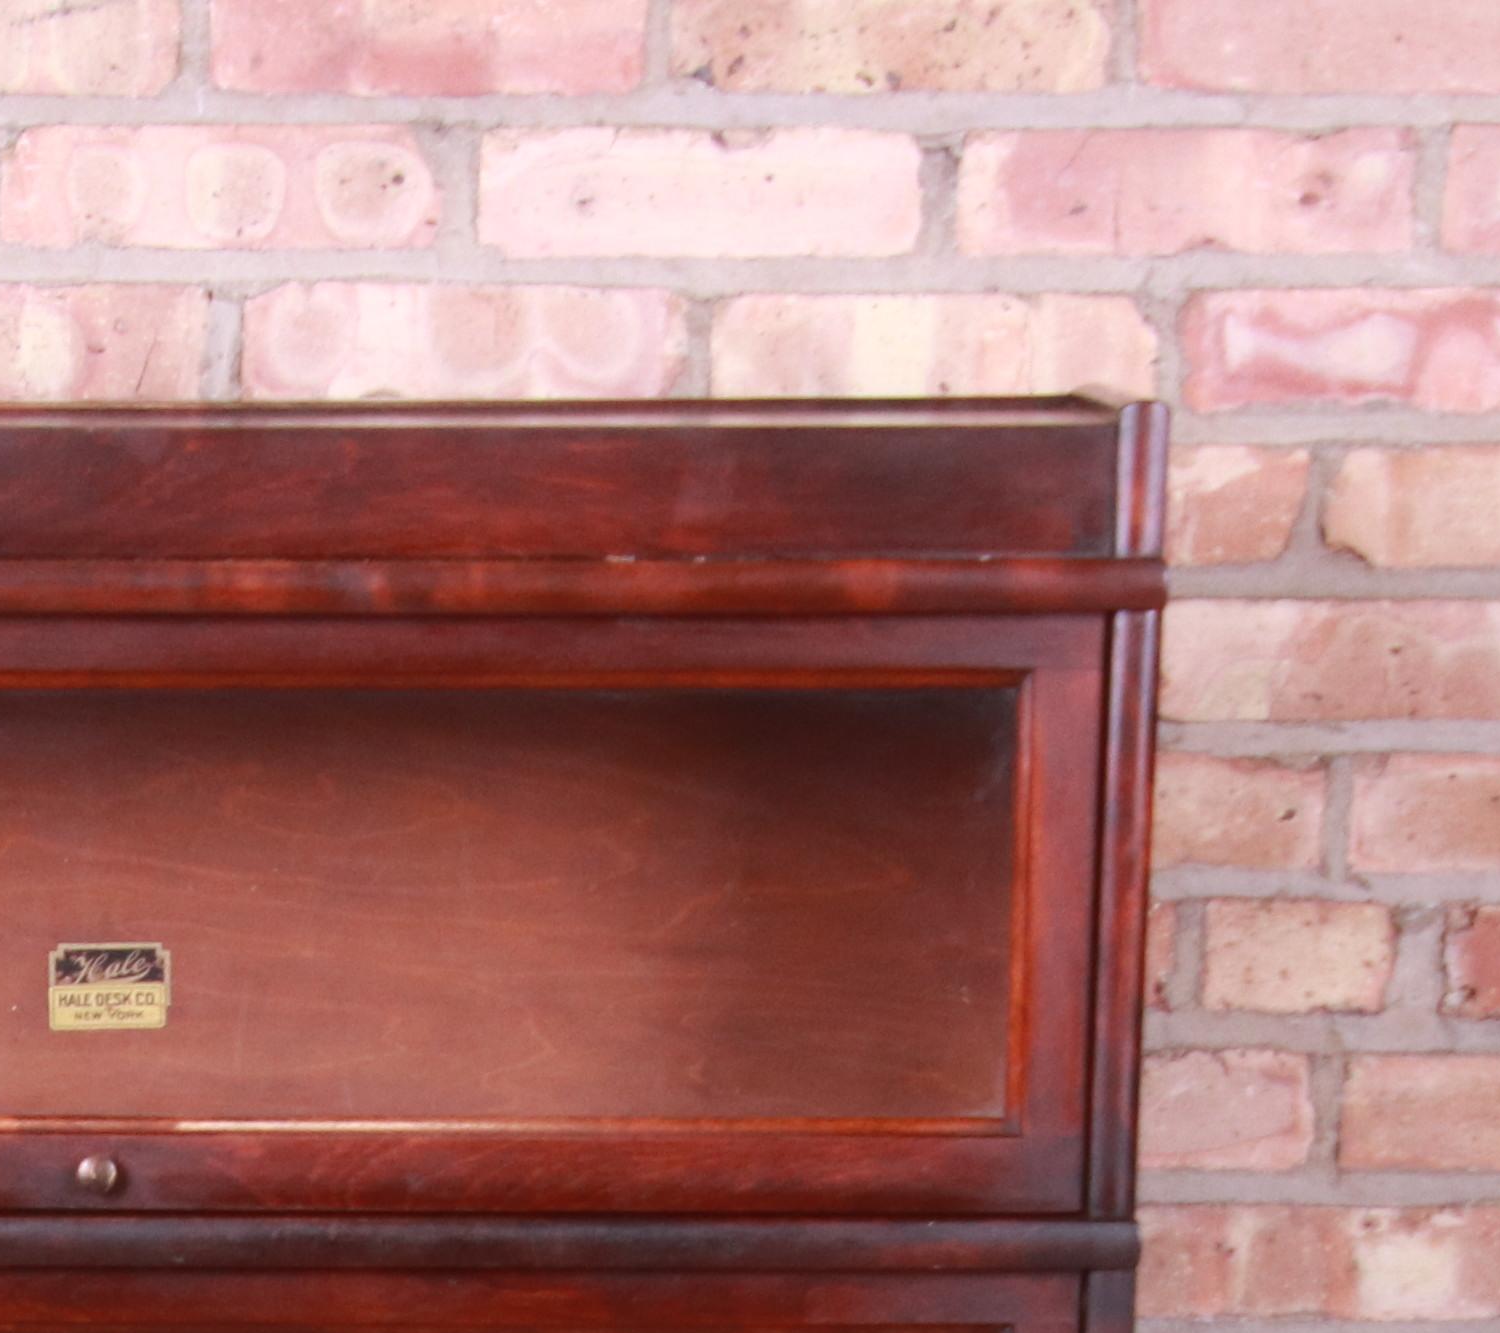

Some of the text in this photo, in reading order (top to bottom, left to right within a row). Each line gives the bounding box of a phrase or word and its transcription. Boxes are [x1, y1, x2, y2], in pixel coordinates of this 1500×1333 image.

[68, 948, 153, 984] Hale
[58, 992, 92, 1007] HALE
[95, 991, 132, 1007] DESK
[74, 1011, 102, 1020] NEW
